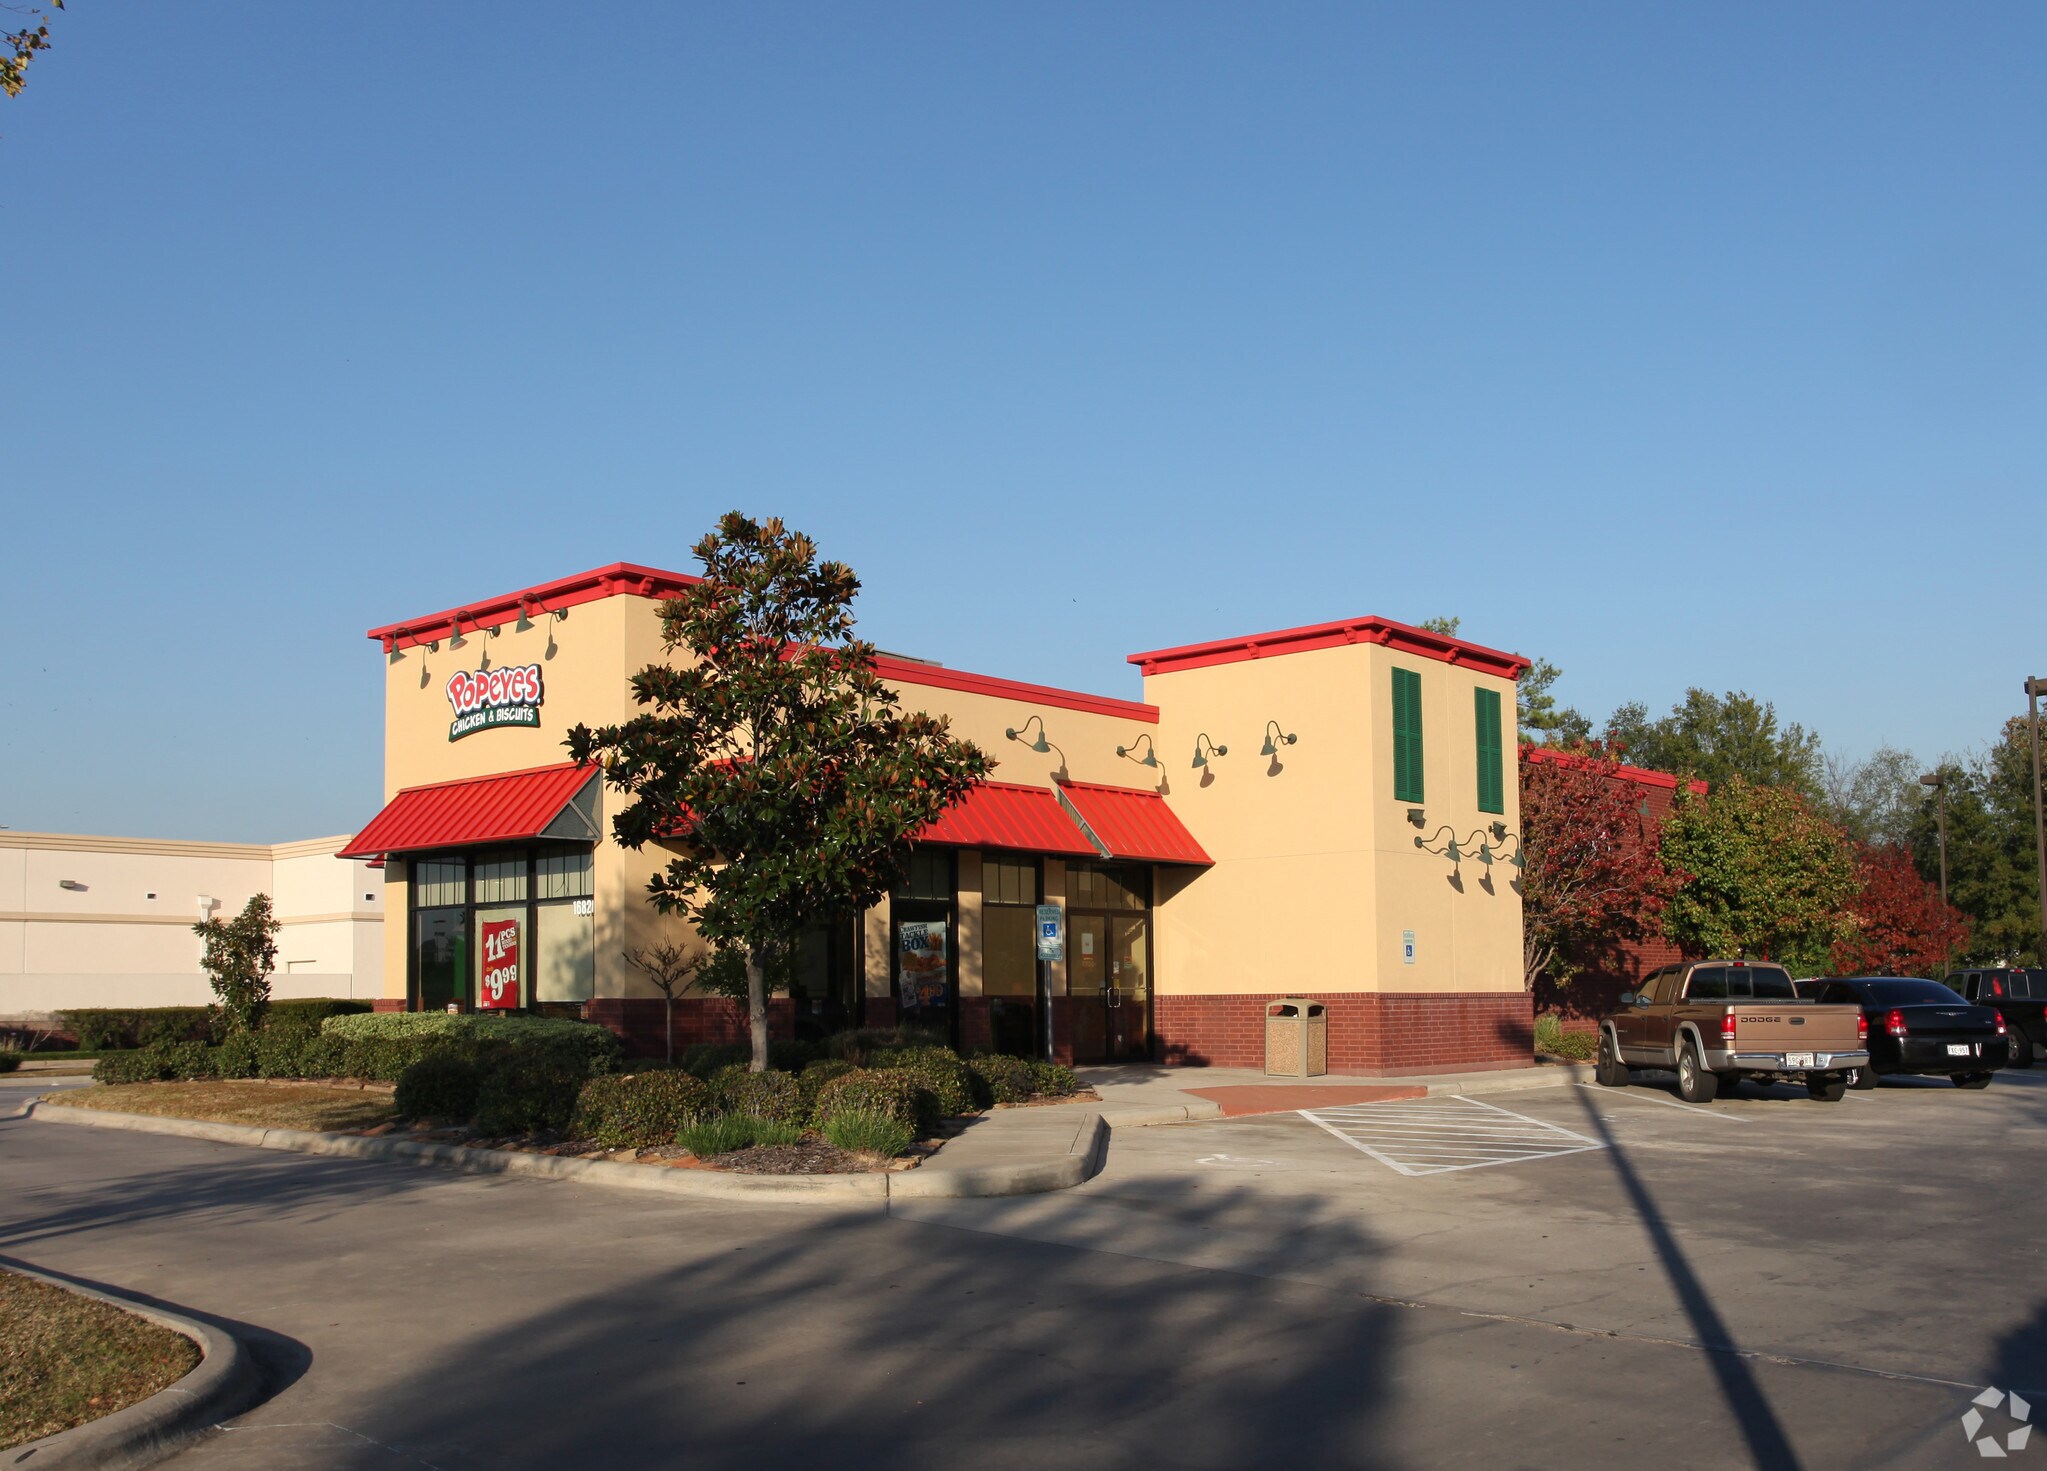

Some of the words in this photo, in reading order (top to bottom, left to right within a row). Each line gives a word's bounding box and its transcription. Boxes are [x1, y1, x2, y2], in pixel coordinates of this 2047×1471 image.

[452, 711, 486, 735] CHICKEN
[488, 710, 495, 722] &
[496, 707, 534, 722] BISCUITS
[899, 923, 928, 933] CRAWFISH
[900, 929, 929, 940] TACKLE
[485, 930, 506, 962] 11
[500, 927, 516, 941] PCS
[902, 936, 930, 952] BOX
